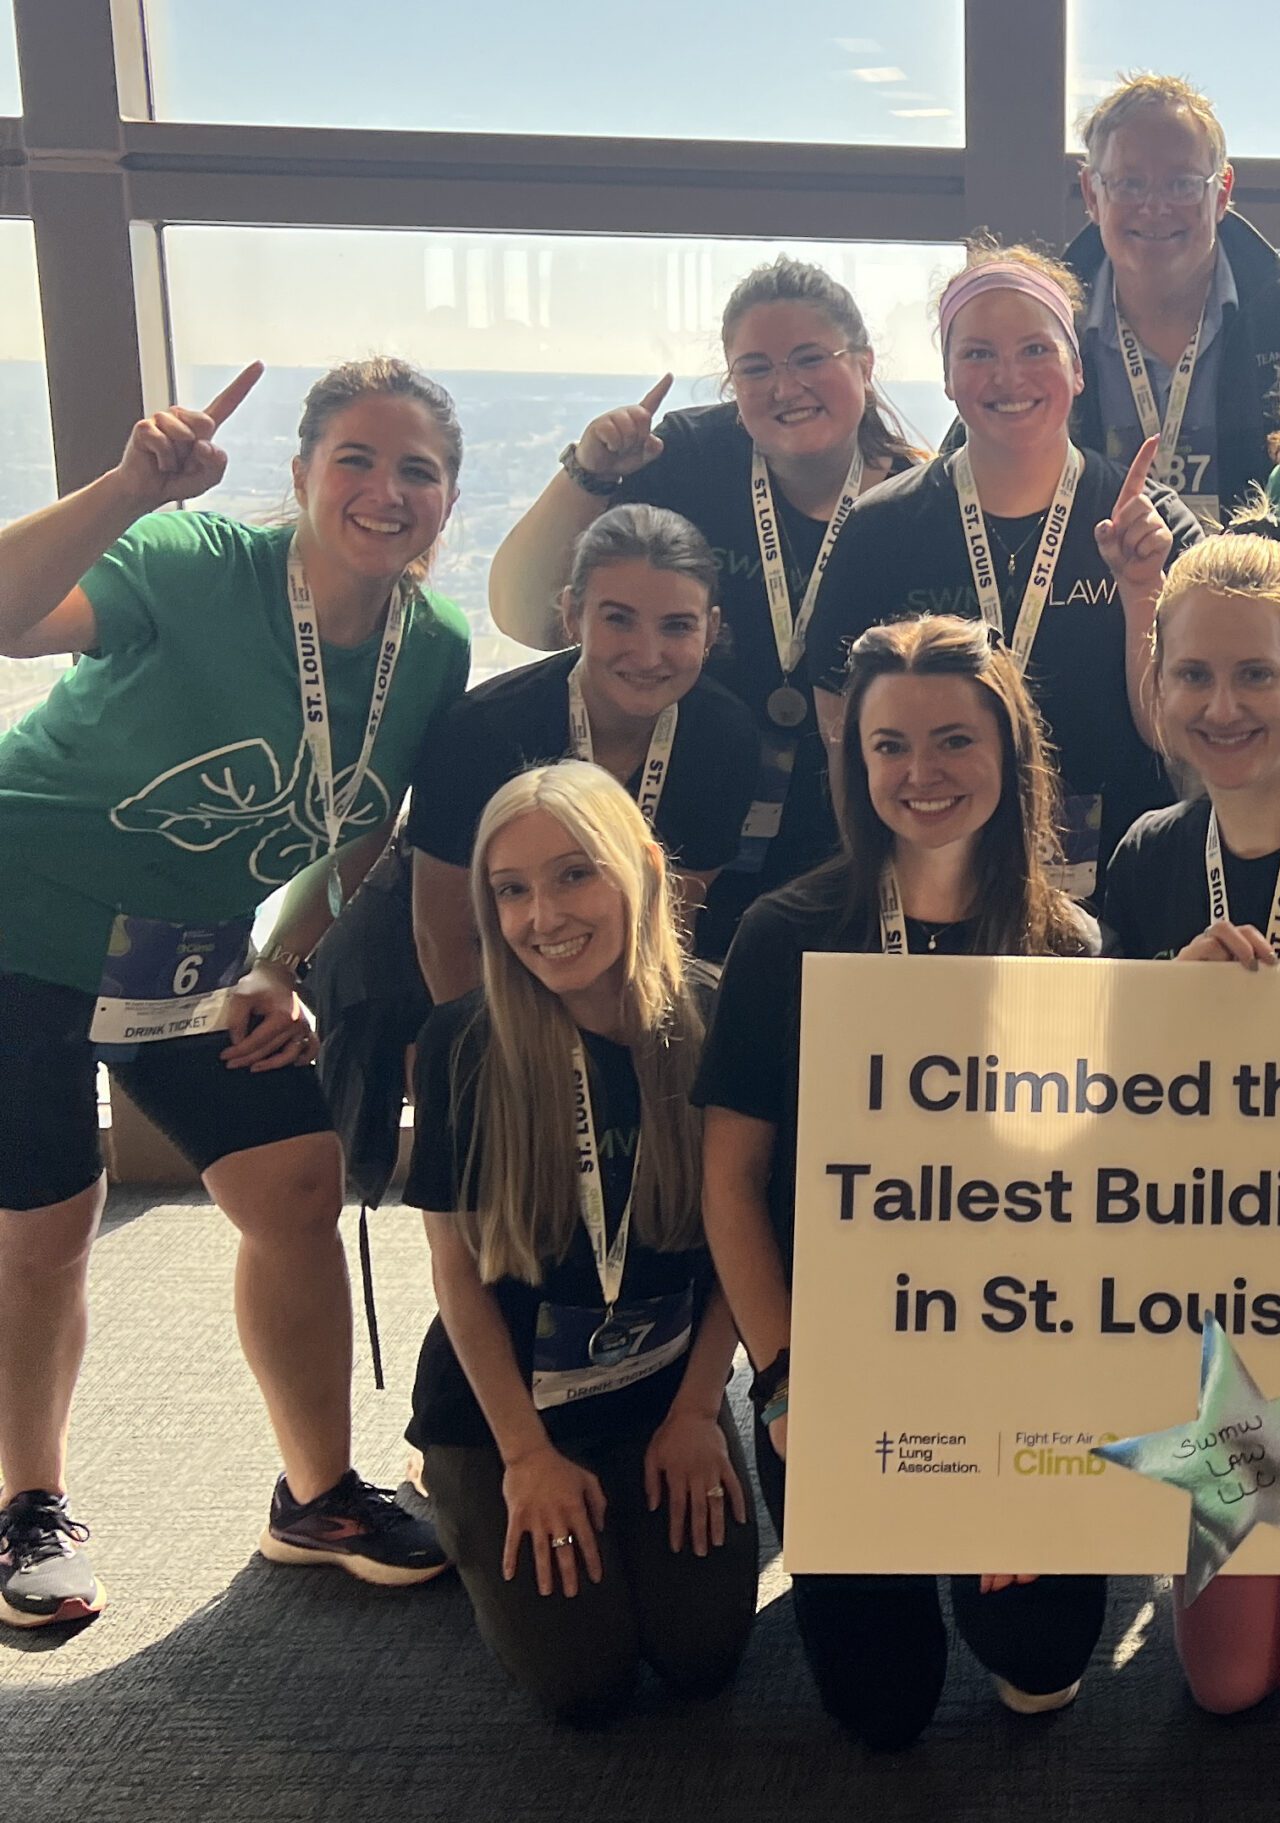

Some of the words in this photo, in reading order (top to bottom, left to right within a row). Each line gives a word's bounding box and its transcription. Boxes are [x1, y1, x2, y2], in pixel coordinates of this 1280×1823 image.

[1122, 329, 1143, 378] LOUIS
[1180, 350, 1195, 375] ST.
[754, 477, 768, 505] ST.
[1147, 454, 1211, 493] 87
[965, 504, 978, 530] ST.
[758, 508, 778, 562] LOUIS
[1034, 563, 1052, 588] ST.
[1048, 504, 1067, 557] LOUIS
[970, 534, 992, 588] LOUIS
[1049, 578, 1119, 606] LAW
[298, 621, 319, 686] LOUIS
[376, 640, 396, 702] LOUIS
[307, 692, 323, 723] ST.
[646, 759, 664, 786] ST.
[1210, 867, 1224, 920] OUIS
[173, 954, 204, 996] 6
[124, 1024, 166, 1039] DRINK
[167, 1015, 208, 1035] TICKET
[868, 1053, 884, 1111] I
[908, 1054, 1212, 1117] Climbed
[825, 1163, 1073, 1224] Tallest
[895, 1272, 957, 1333] in
[981, 1275, 1074, 1334] St.
[898, 1432, 967, 1445] American
[899, 1447, 933, 1461] Lung
[1015, 1432, 1049, 1447] Fight
[1053, 1432, 1074, 1445] For
[1076, 1432, 1094, 1445] Air
[897, 1461, 982, 1475] Association.
[1013, 1448, 1107, 1476] Climb
[1217, 1470, 1276, 1505] LLC
